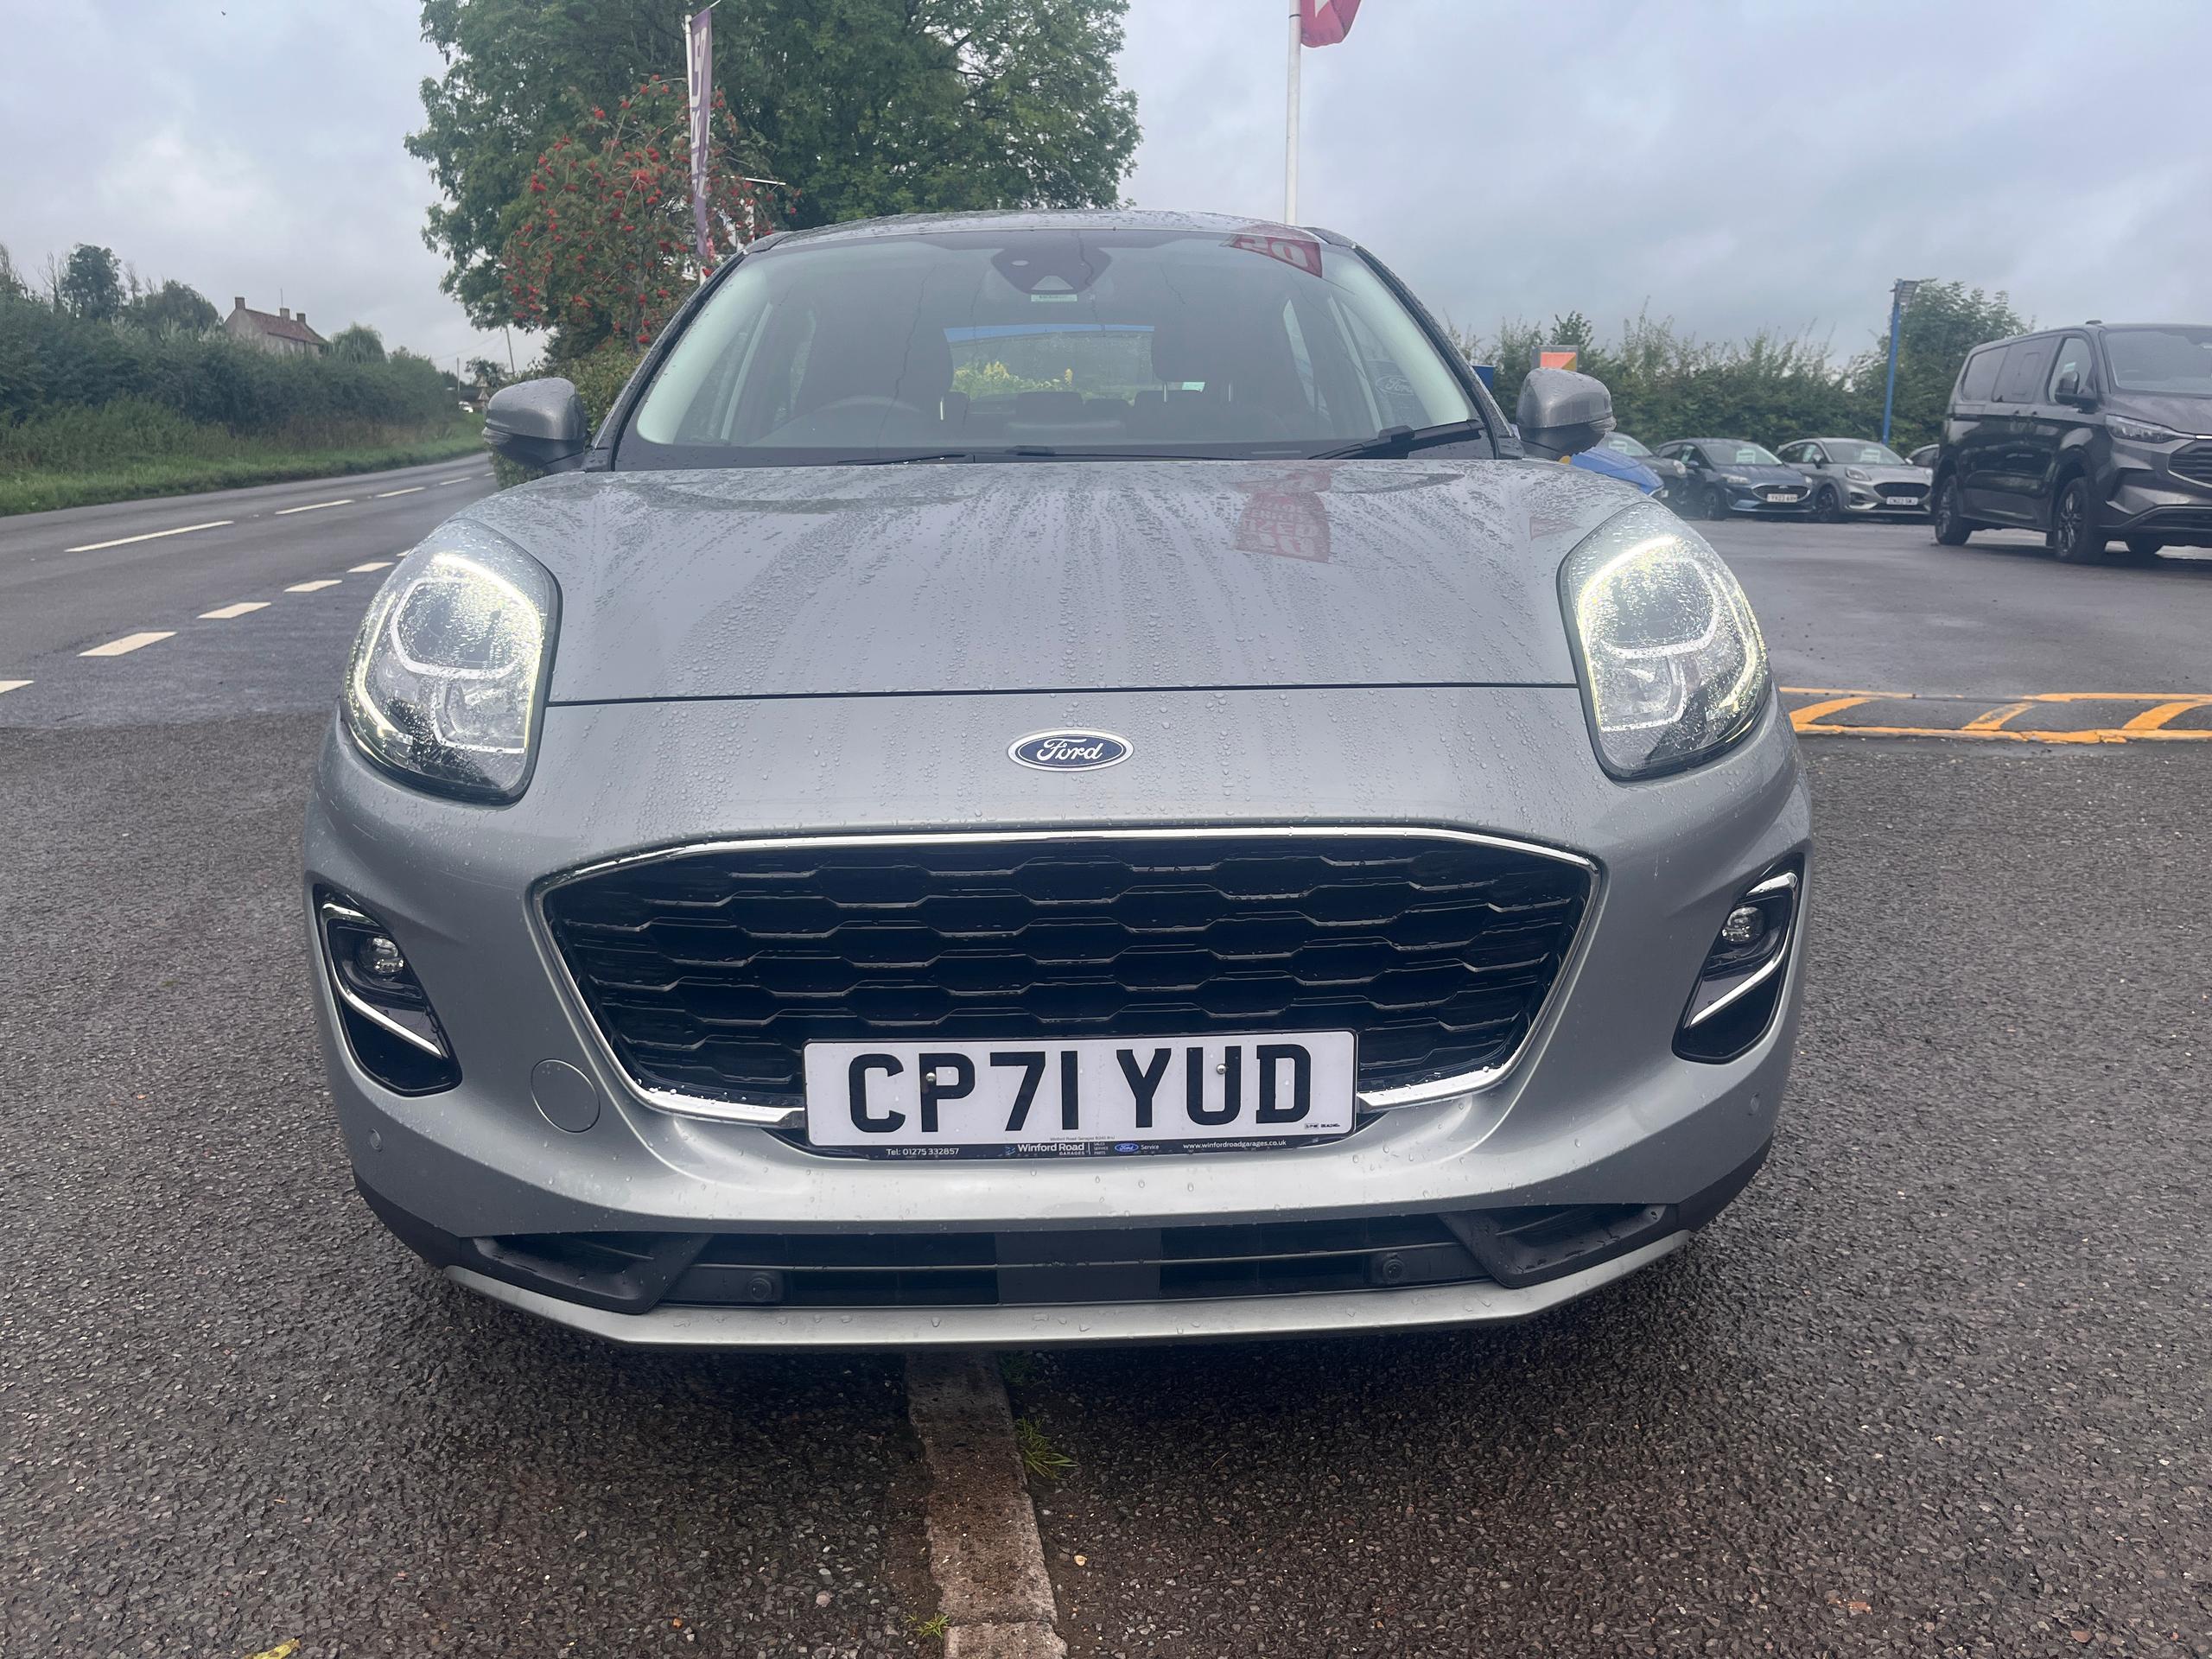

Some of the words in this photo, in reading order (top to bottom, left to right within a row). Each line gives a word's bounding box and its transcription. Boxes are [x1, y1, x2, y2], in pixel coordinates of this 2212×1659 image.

[1036, 737, 1104, 761] Ford
[849, 1051, 1079, 1133] CP71
[1116, 1043, 1312, 1128] YUD
[1018, 1142, 1058, 1153] Winford
[1058, 1142, 1085, 1151] Road
[1182, 1140, 1287, 1149] www.winfordroadgarages.co.uk
